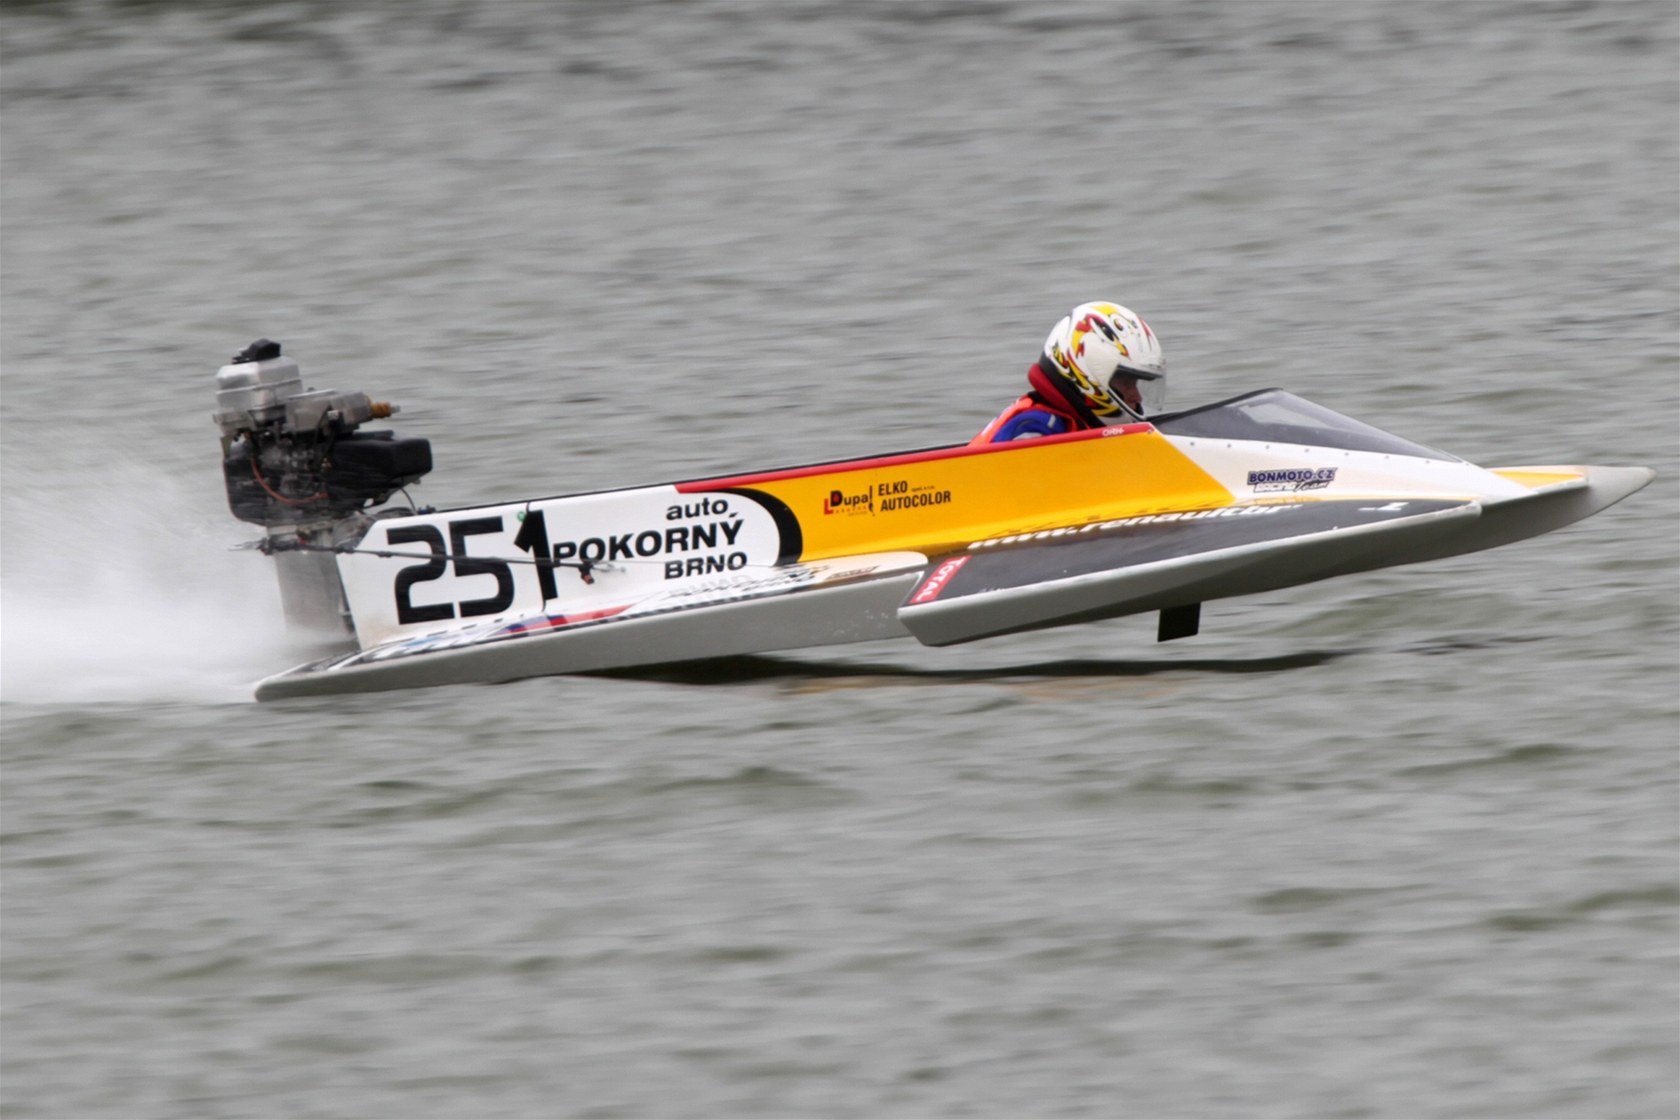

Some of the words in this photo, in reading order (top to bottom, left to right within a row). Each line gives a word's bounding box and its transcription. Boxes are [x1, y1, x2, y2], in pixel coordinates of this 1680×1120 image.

[878, 480, 908, 496] ELKO
[880, 490, 951, 511] AUTOCOLOR
[666, 497, 729, 521] auto
[553, 512, 744, 567] POKORNÝ
[386, 509, 558, 625] 251
[664, 551, 748, 579] BRNO
[915, 556, 967, 601] TOTAL
